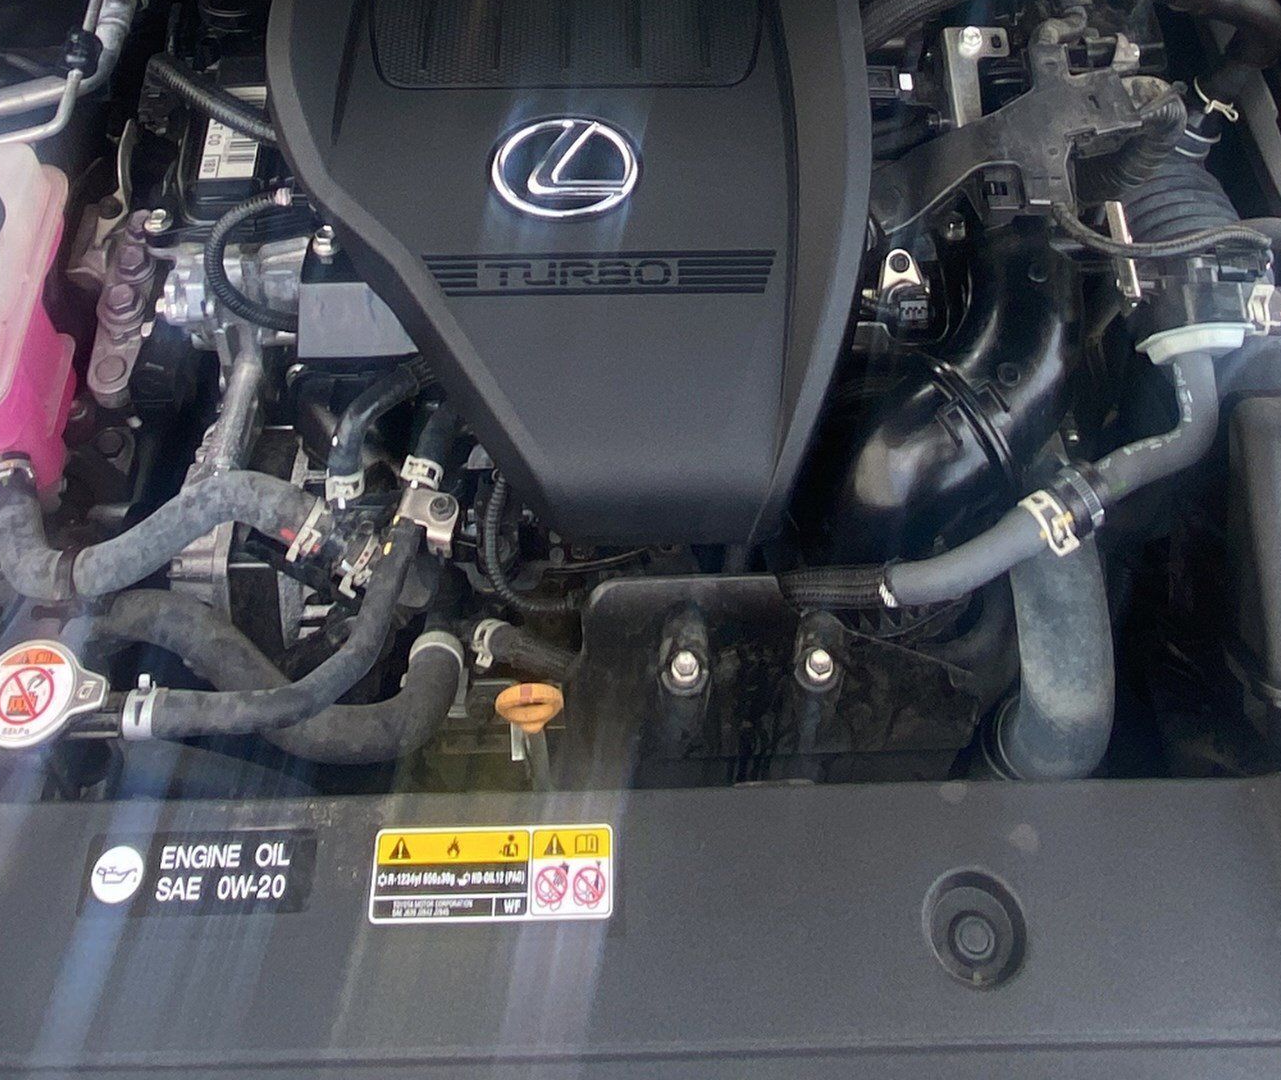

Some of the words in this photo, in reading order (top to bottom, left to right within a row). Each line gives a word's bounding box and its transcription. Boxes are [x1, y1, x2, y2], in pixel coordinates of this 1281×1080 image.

[485, 259, 671, 286] TURBO
[160, 844, 241, 869] ENGINE
[255, 843, 290, 867] OIL
[155, 876, 203, 902] SAE
[217, 874, 286, 900] 0W-20
